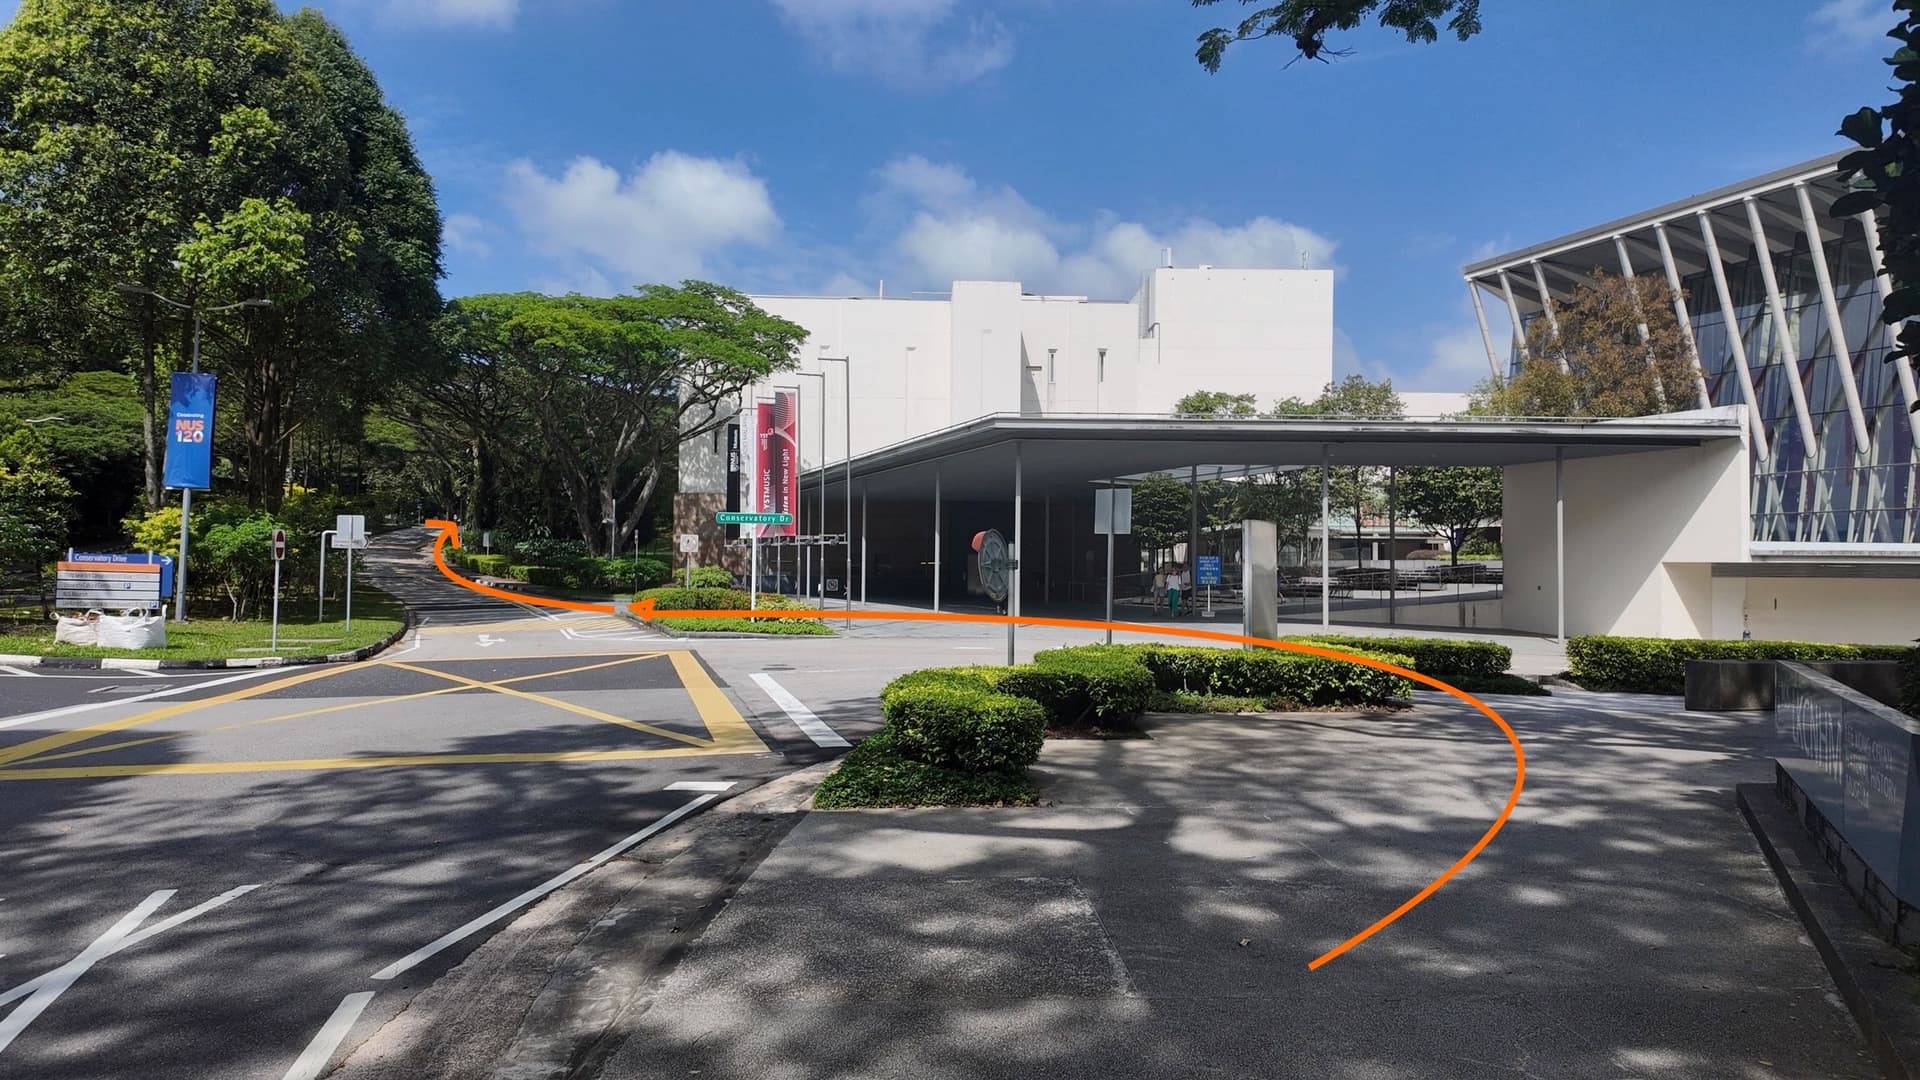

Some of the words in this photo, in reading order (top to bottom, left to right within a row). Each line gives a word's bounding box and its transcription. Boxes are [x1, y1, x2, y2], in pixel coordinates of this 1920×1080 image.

[176, 420, 204, 431] NUS
[176, 430, 204, 443] 120
[782, 448, 790, 467] Light
[782, 486, 789, 494] in
[720, 514, 776, 523] Conservatory
[74, 553, 111, 563] Conservatory
[112, 554, 128, 562] Drive
